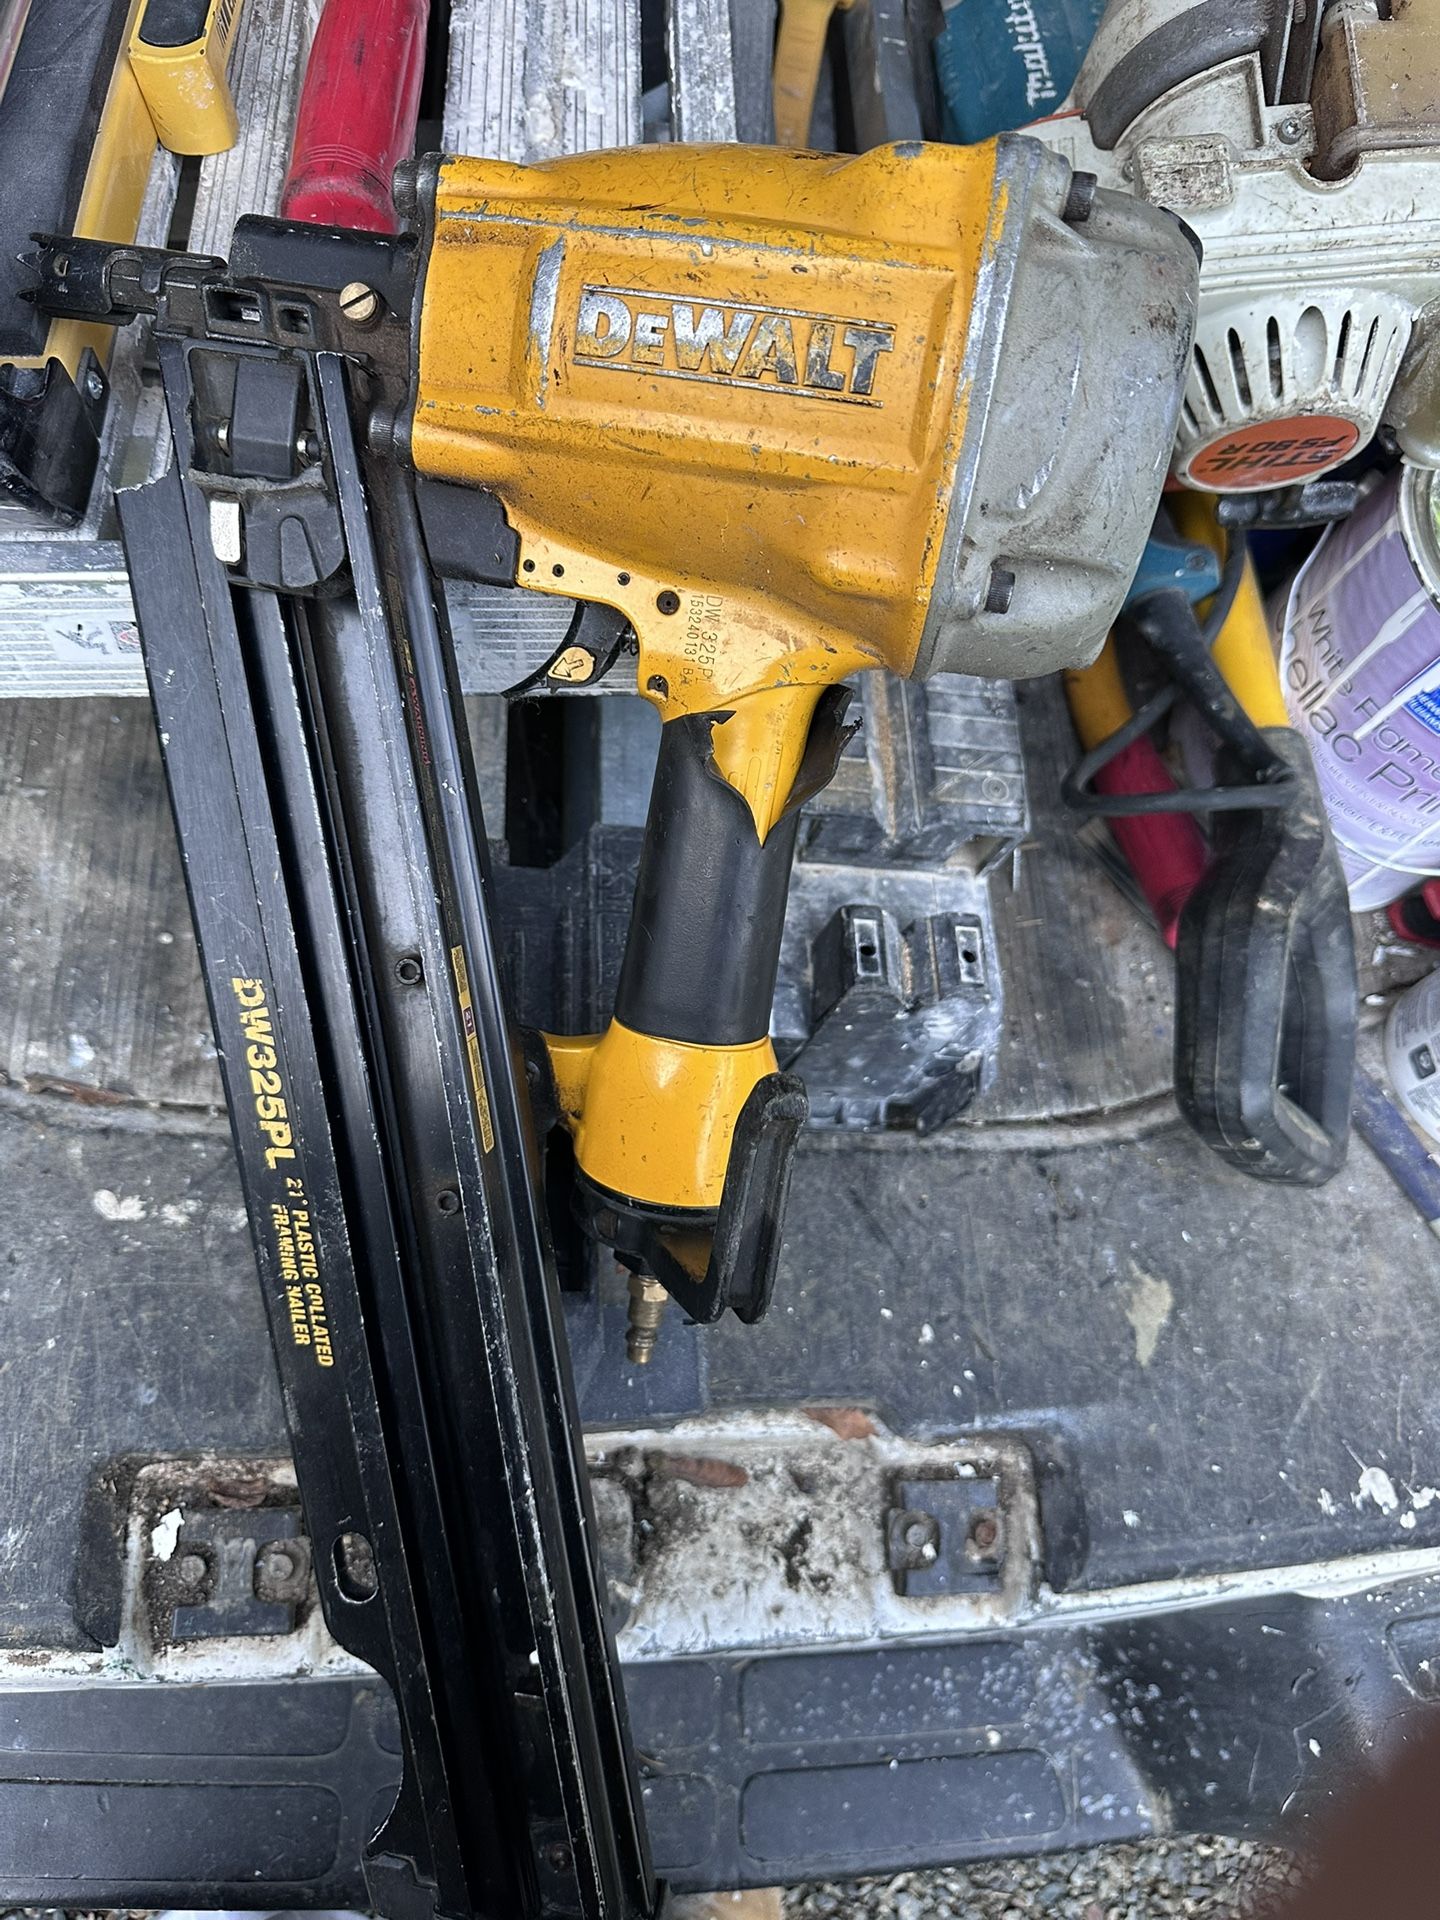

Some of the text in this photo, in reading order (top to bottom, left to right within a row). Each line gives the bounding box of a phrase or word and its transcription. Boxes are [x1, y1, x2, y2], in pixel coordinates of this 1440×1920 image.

[1206, 448, 1345, 472] STIHL
[704, 595, 723, 623] DW
[1308, 600, 1353, 697] White
[231, 977, 297, 1170] DW325PL
[271, 1203, 311, 1346] FRAMING NAILER
[292, 1209, 319, 1279] PLASTIC
[305, 1283, 334, 1367] COLLATED
